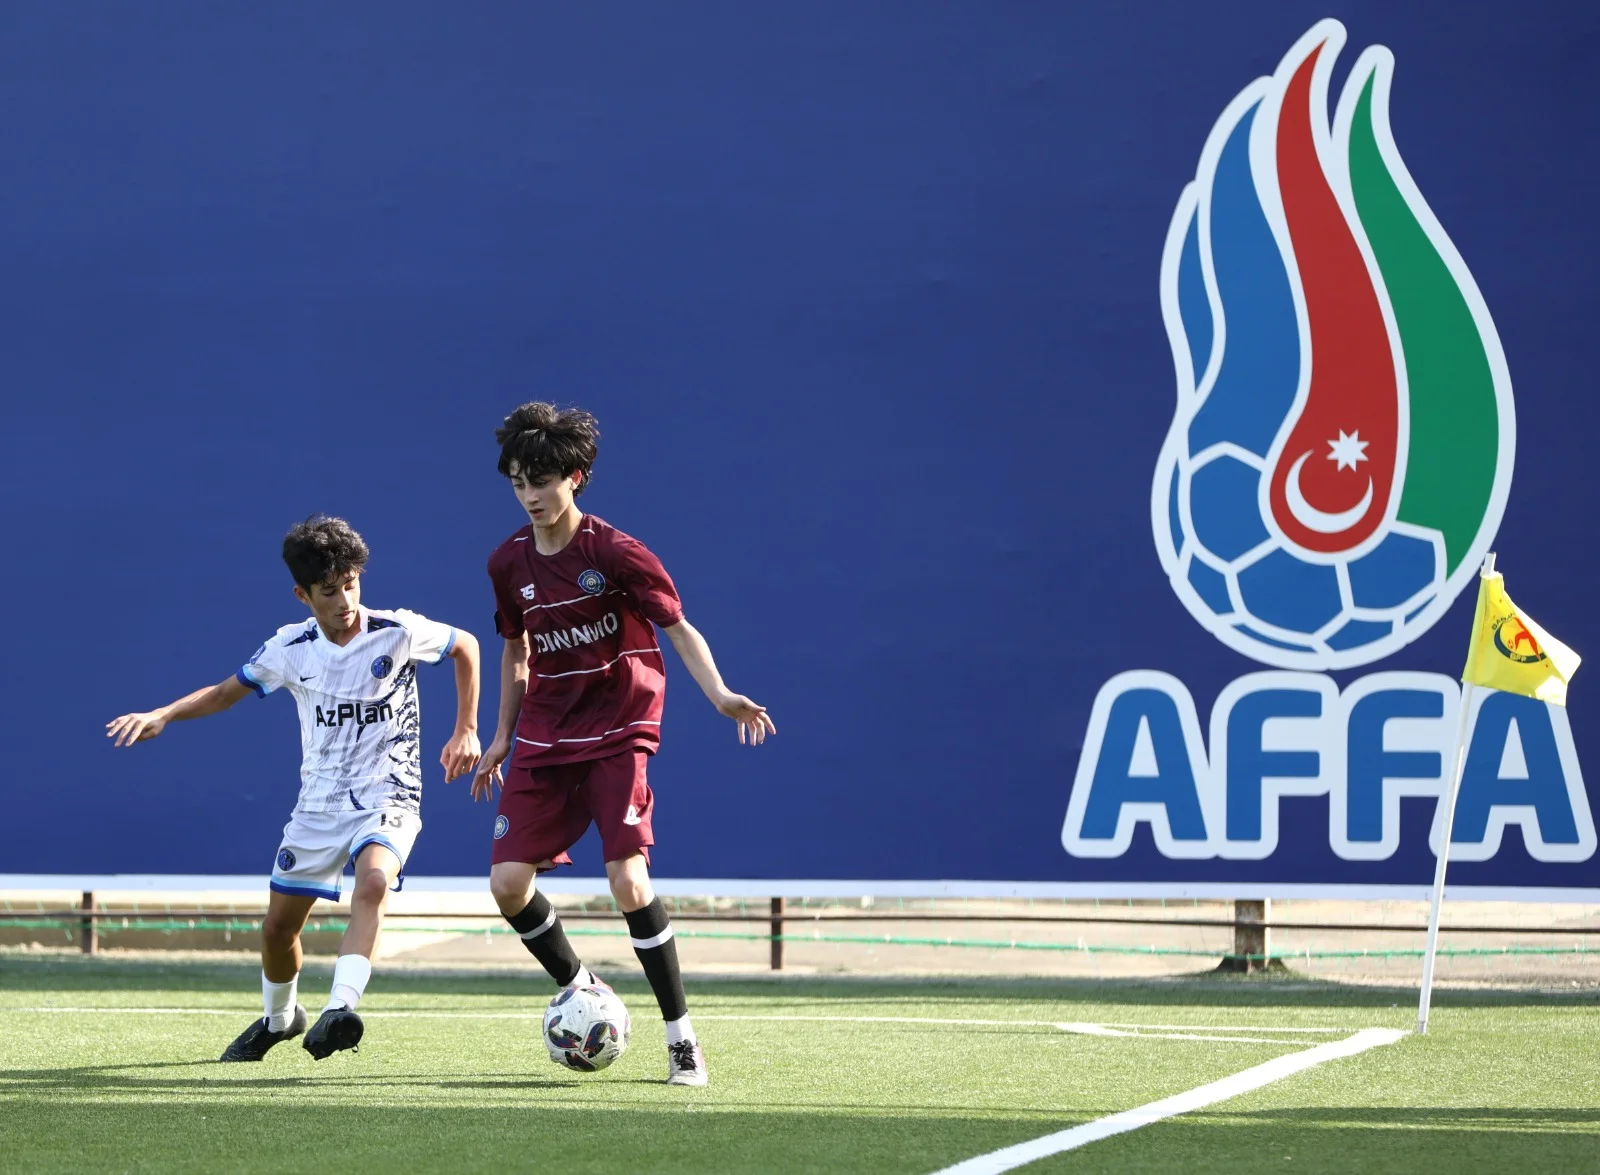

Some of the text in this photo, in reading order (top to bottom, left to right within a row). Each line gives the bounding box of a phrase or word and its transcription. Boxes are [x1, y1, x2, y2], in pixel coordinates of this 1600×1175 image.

[533, 612, 618, 654] DINAMO
[315, 702, 394, 728] AzPlan
[1062, 670, 1597, 862] AFFA
